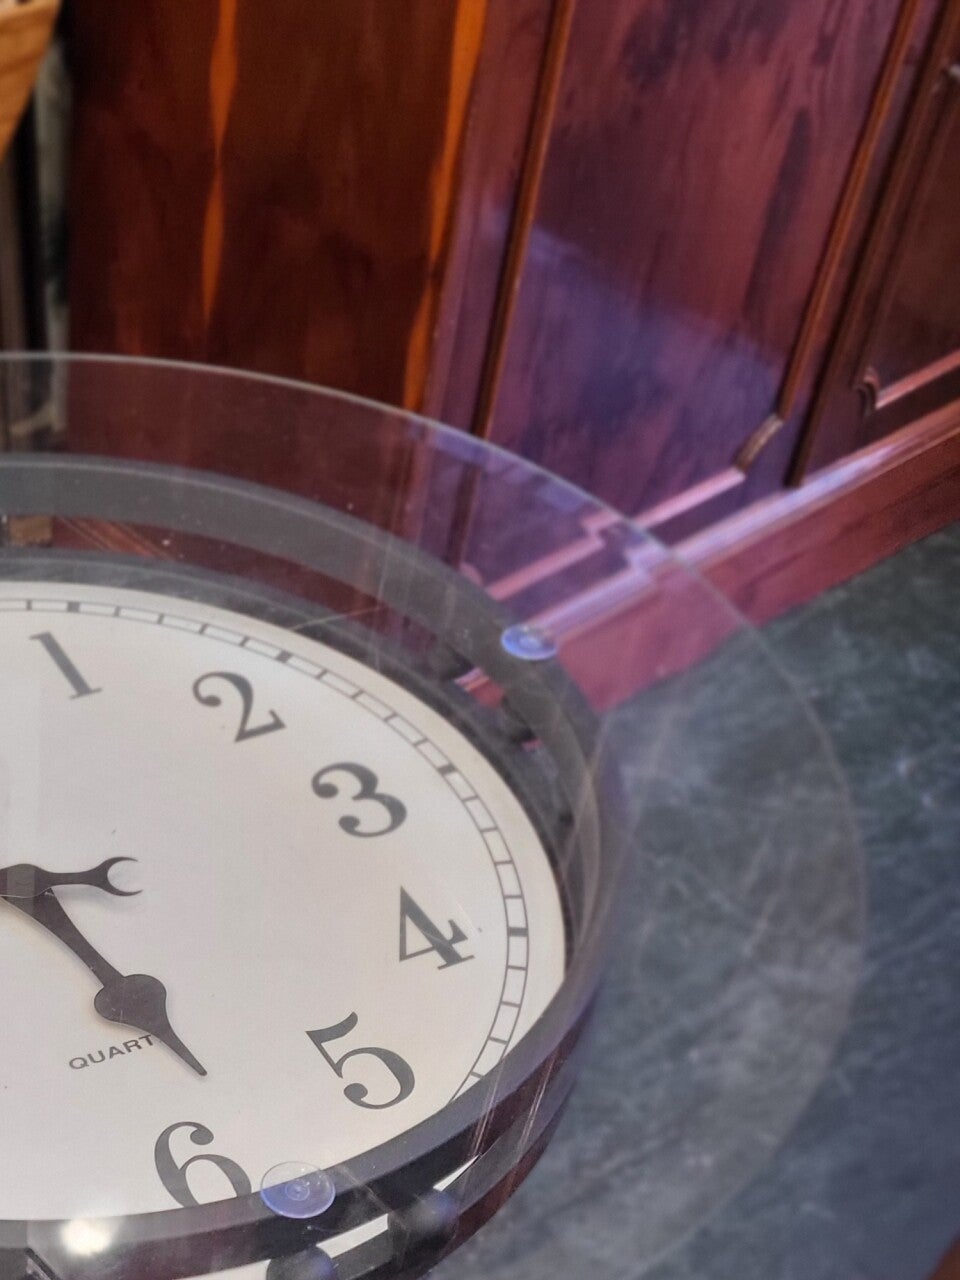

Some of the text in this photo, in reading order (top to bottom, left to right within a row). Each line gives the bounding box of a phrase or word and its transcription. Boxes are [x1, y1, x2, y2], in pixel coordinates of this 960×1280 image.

[28, 631, 102, 699] 1
[191, 671, 287, 743] 2
[310, 762, 407, 837] 3
[398, 885, 475, 970] 4
[68, 1034, 154, 1070] QUART
[305, 1011, 415, 1109] 5
[154, 1121, 252, 1208] 6
